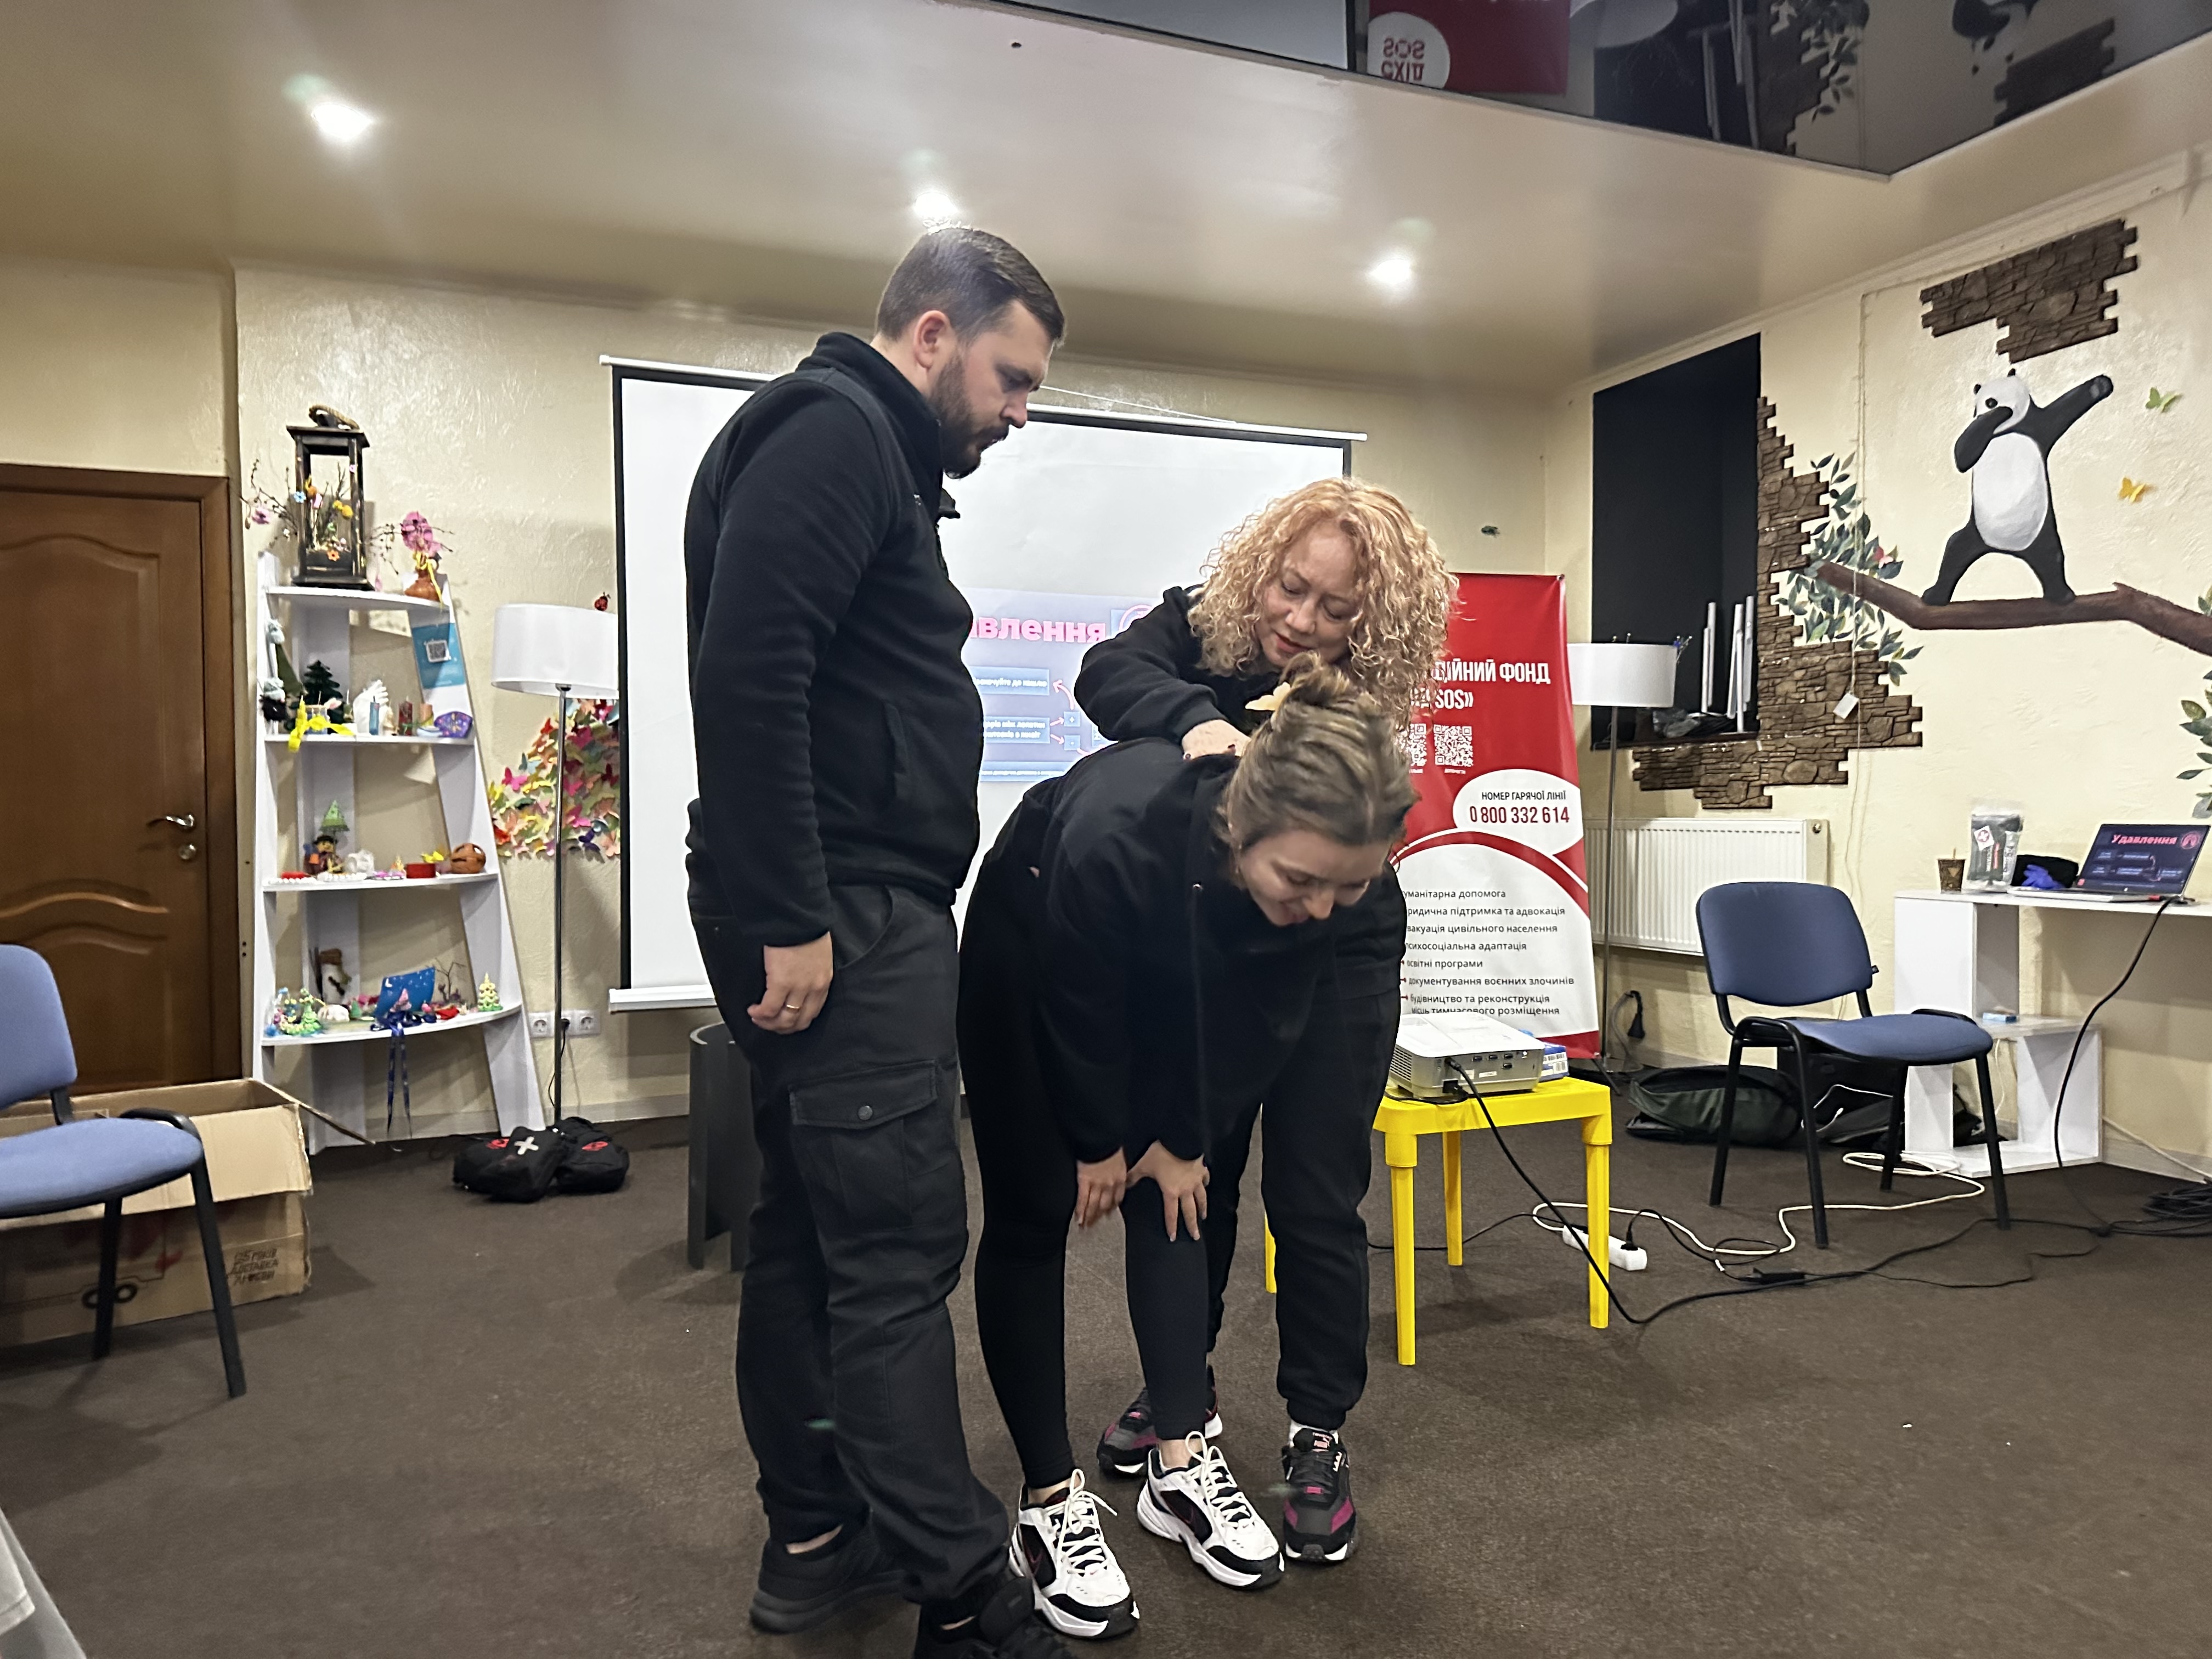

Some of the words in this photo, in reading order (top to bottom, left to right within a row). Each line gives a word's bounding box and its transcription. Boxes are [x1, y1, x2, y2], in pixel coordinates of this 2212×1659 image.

[1432, 658, 1497, 684] ДІЙНИЙ
[1499, 662, 1551, 685] ФОНД
[1435, 689, 1474, 709] SOS»
[1481, 792, 1510, 800] НОМЕР
[1511, 790, 1545, 800] ГАРЯЧОЇ
[1547, 790, 1566, 800] ЛІНІЇ
[1469, 805, 1477, 823] 0
[1480, 806, 1507, 823] 800
[1510, 806, 1538, 823] 332
[1542, 806, 1570, 823] 614
[1402, 889, 1456, 900] уманітарна
[1458, 891, 1506, 900] допомога
[1408, 908, 1448, 917] ридична
[1450, 907, 1503, 917] підтримка
[1516, 907, 1565, 917] адвокація
[1407, 924, 1445, 935] вакуація
[1448, 925, 1504, 934] цивільного
[1478, 942, 1527, 952] адаптація
[1407, 959, 1432, 968] освітні
[1435, 961, 1483, 970] програми
[1408, 978, 1482, 988] документування
[1528, 977, 1575, 986] злочинів
[1410, 994, 1463, 1005] будівництво
[1477, 995, 1550, 1005] реконструкція
[1498, 1006, 1560, 1018] розміщення
